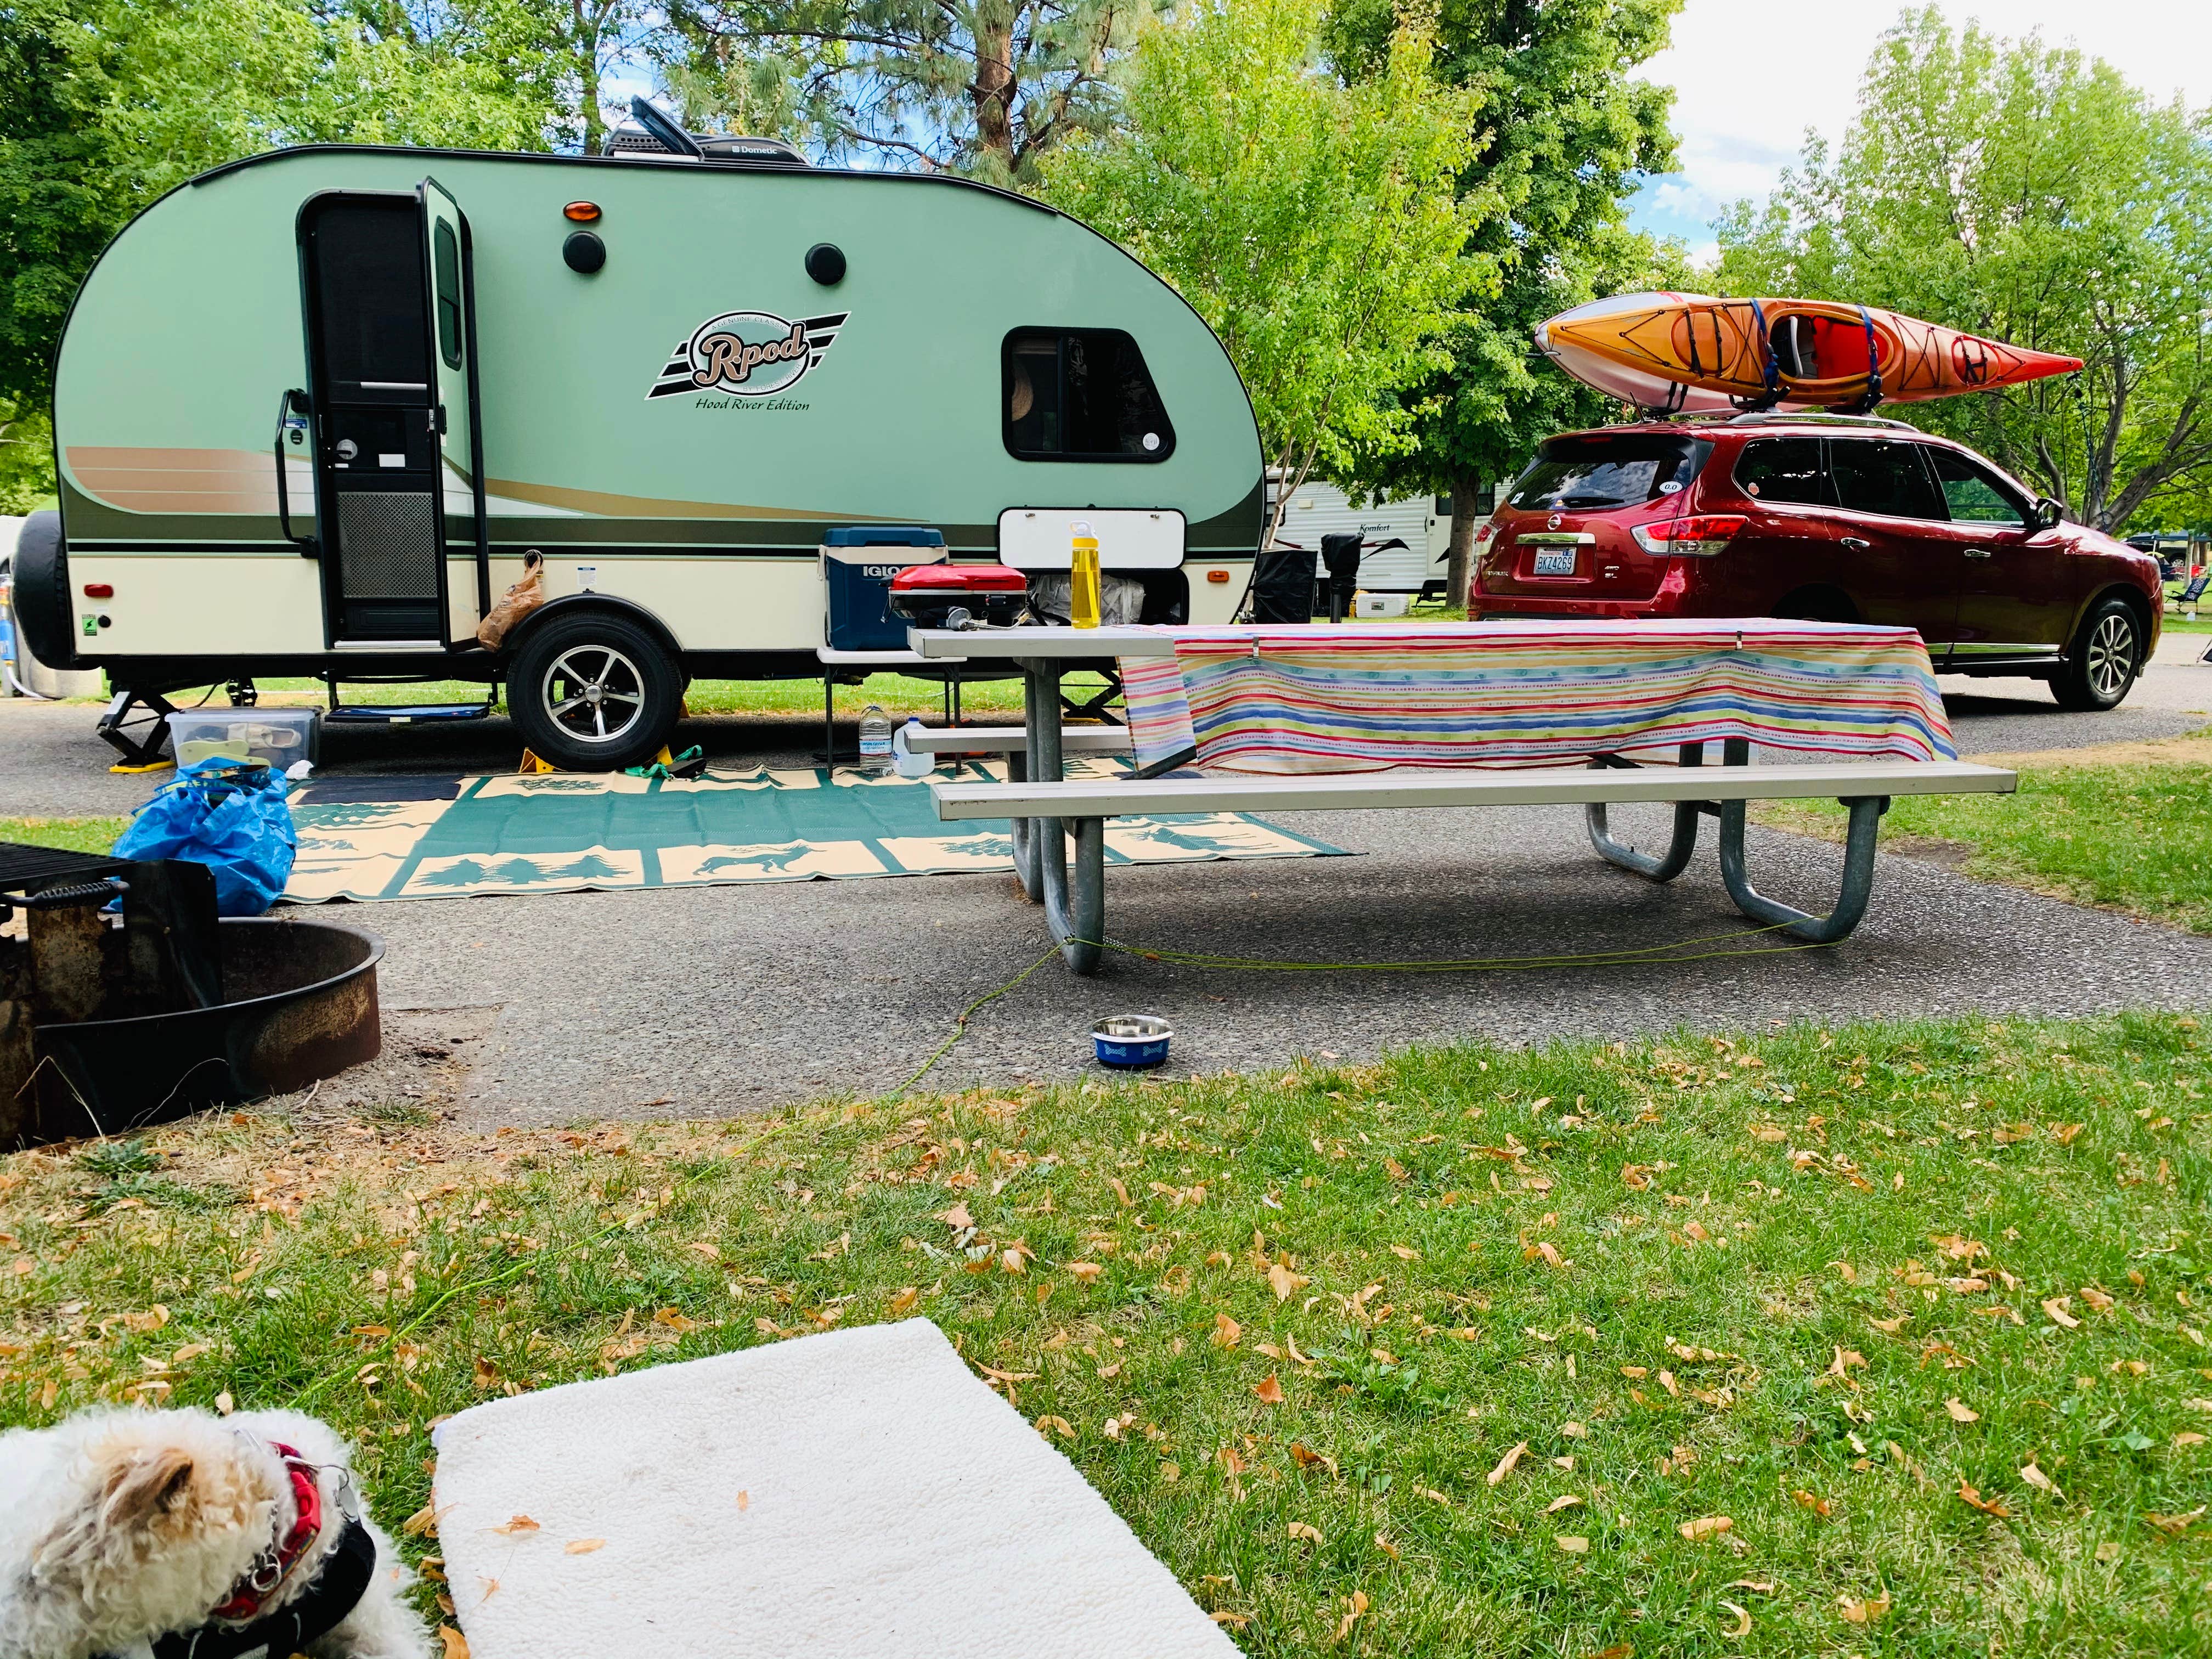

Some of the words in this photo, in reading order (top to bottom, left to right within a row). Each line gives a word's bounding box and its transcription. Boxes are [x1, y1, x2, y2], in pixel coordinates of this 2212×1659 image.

[718, 317, 752, 328] GENUINE
[754, 317, 788, 332] CLASSIC
[756, 380, 784, 391] FOREST
[785, 364, 802, 381] RIVER
[695, 397, 730, 409] Hood
[731, 399, 764, 410] River
[767, 398, 810, 411] Edition
[1360, 523, 1390, 533] Komfort
[1537, 556, 1572, 569] BKZ4269
[863, 566, 909, 577] IGLO
